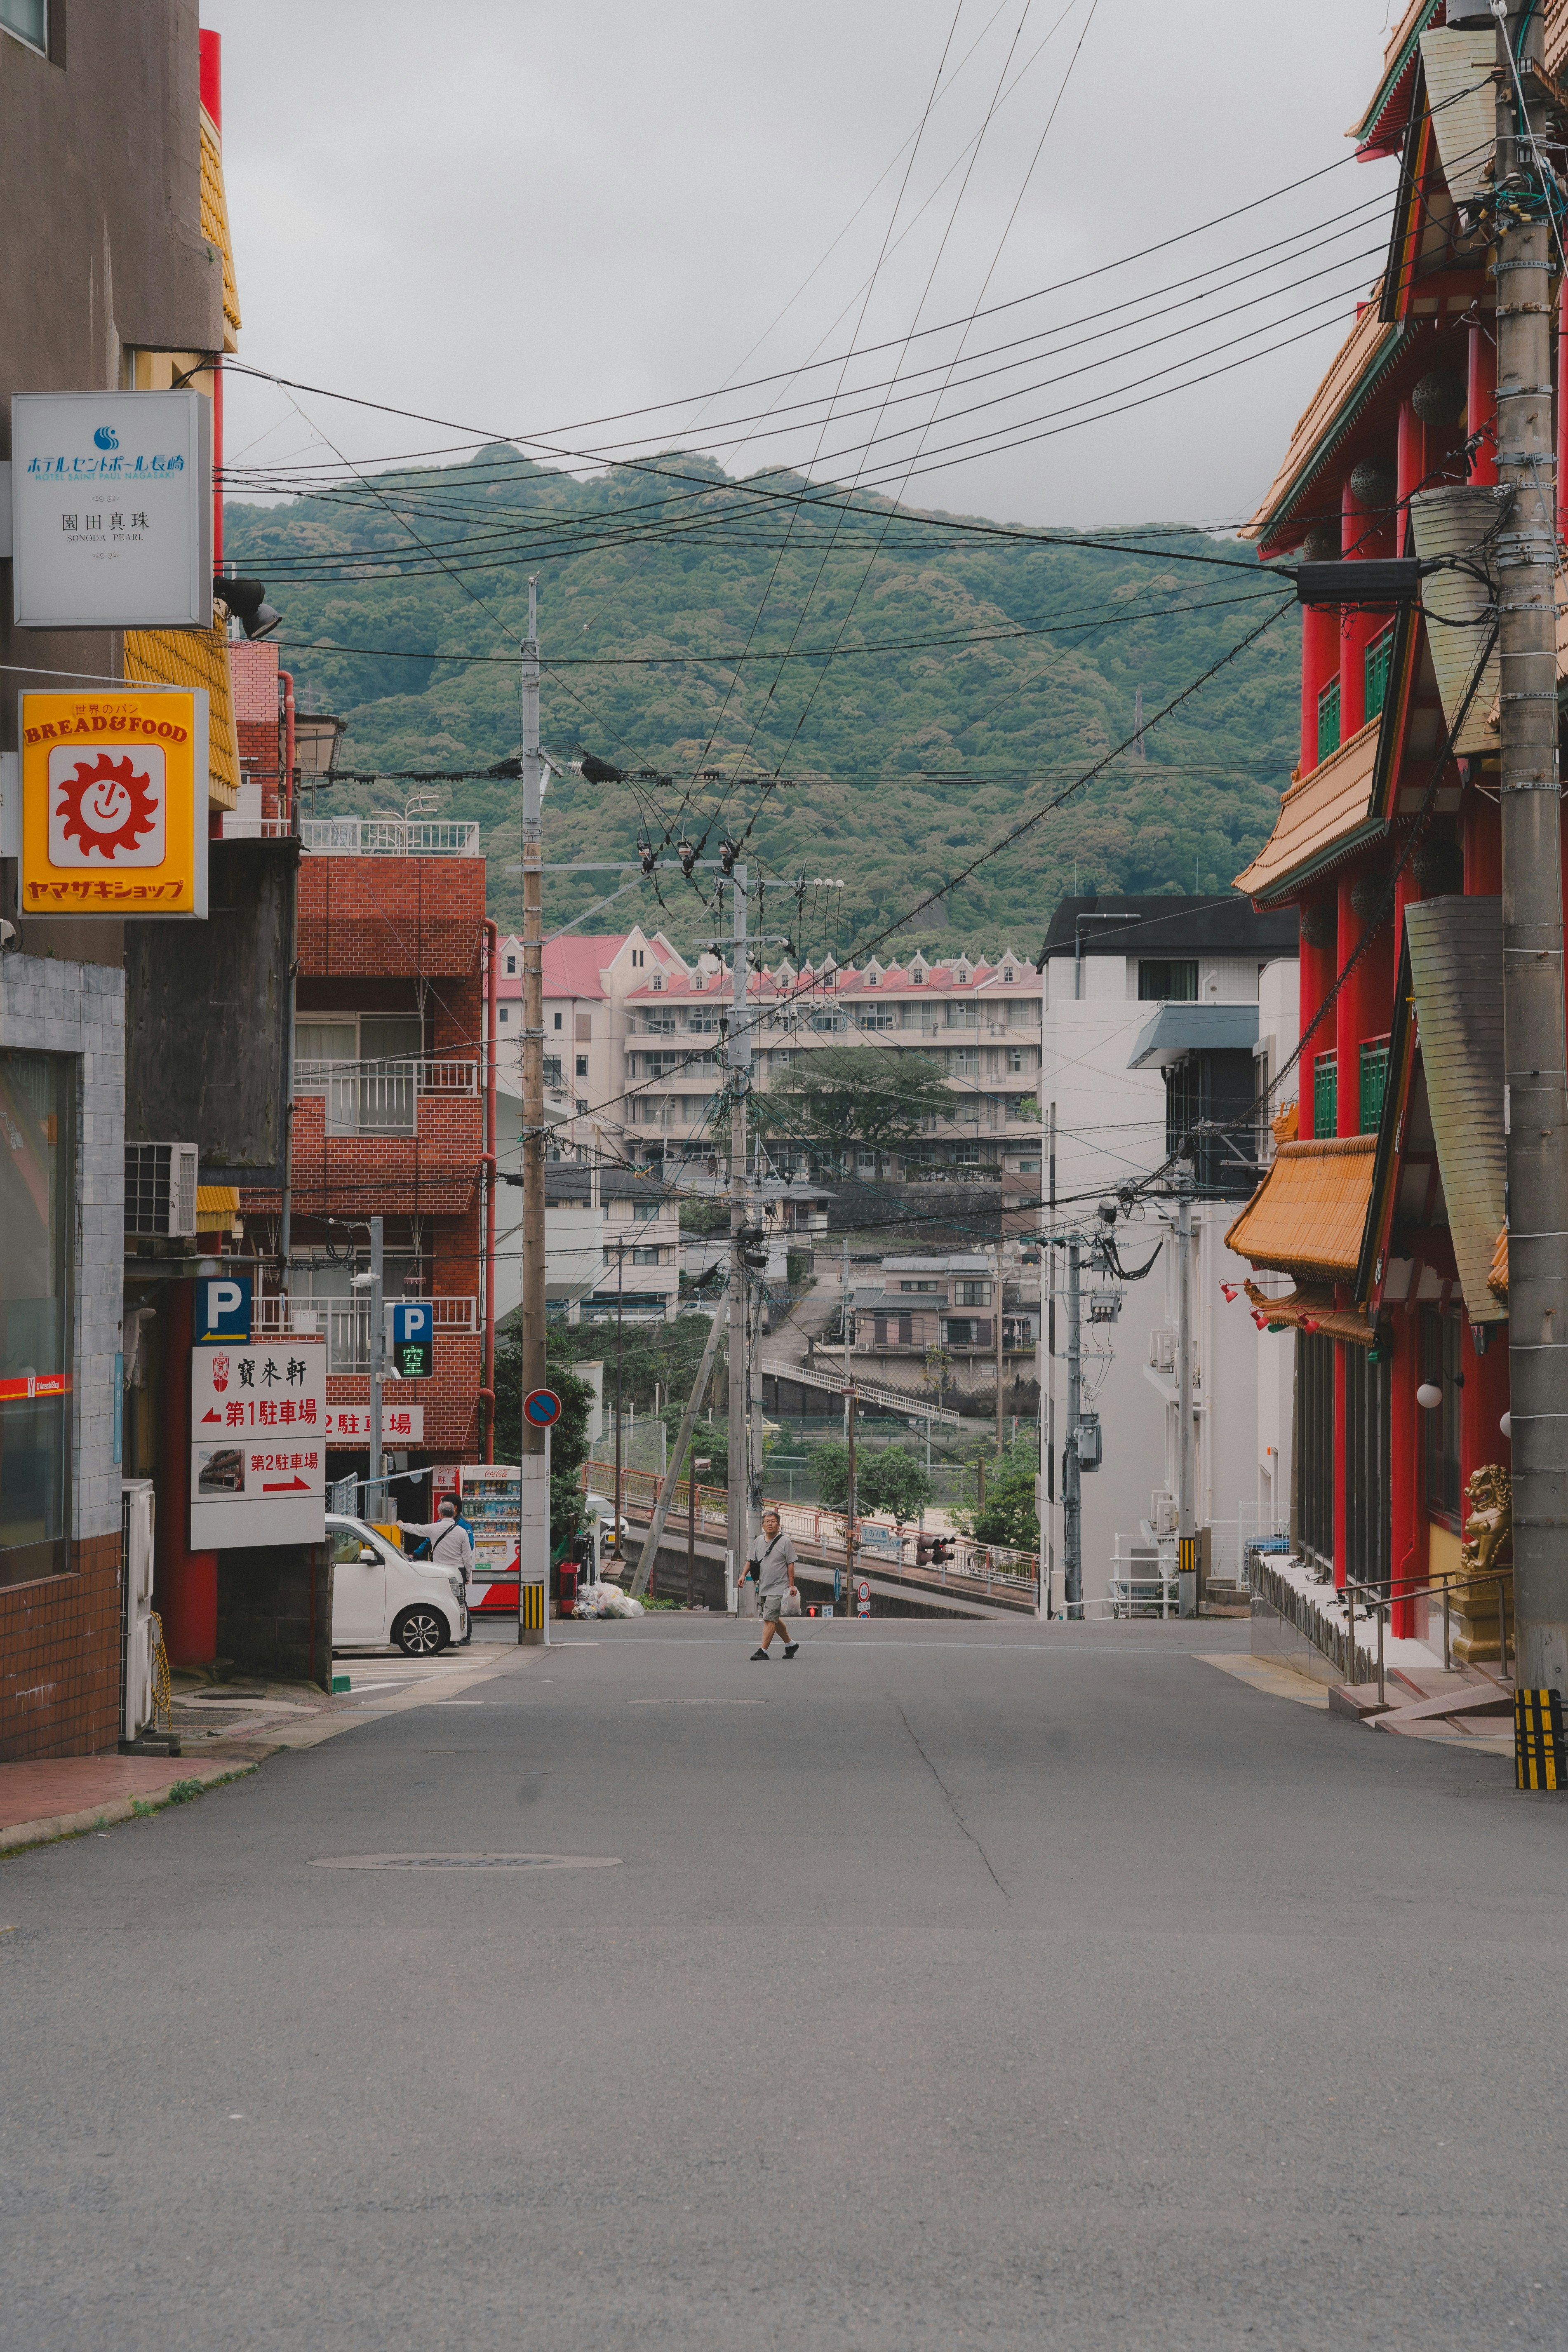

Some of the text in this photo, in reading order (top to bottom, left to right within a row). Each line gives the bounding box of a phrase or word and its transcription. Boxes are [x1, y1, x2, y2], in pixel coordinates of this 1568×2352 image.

[28, 454, 185, 473] ホテルセントポール長崎
[35, 471, 175, 481] HOTEL SAINT PAUL NAGASAKI
[62, 511, 150, 531] 園田真珠
[67, 534, 106, 542] SONODA
[74, 703, 138, 716] 世界のパン
[25, 716, 188, 744] BREAD&FOOD
[28, 879, 184, 899] ヤマザキショップ
[207, 1282, 242, 1328] P
[405, 1308, 425, 1339] P
[403, 1345, 423, 1373] 空
[226, 1398, 317, 1427] 第1駐車場
[251, 1452, 318, 1472] 第2駐車場
[862, 1529, 886, 1539] 下の川橋
[861, 1587, 867, 1597] 40
